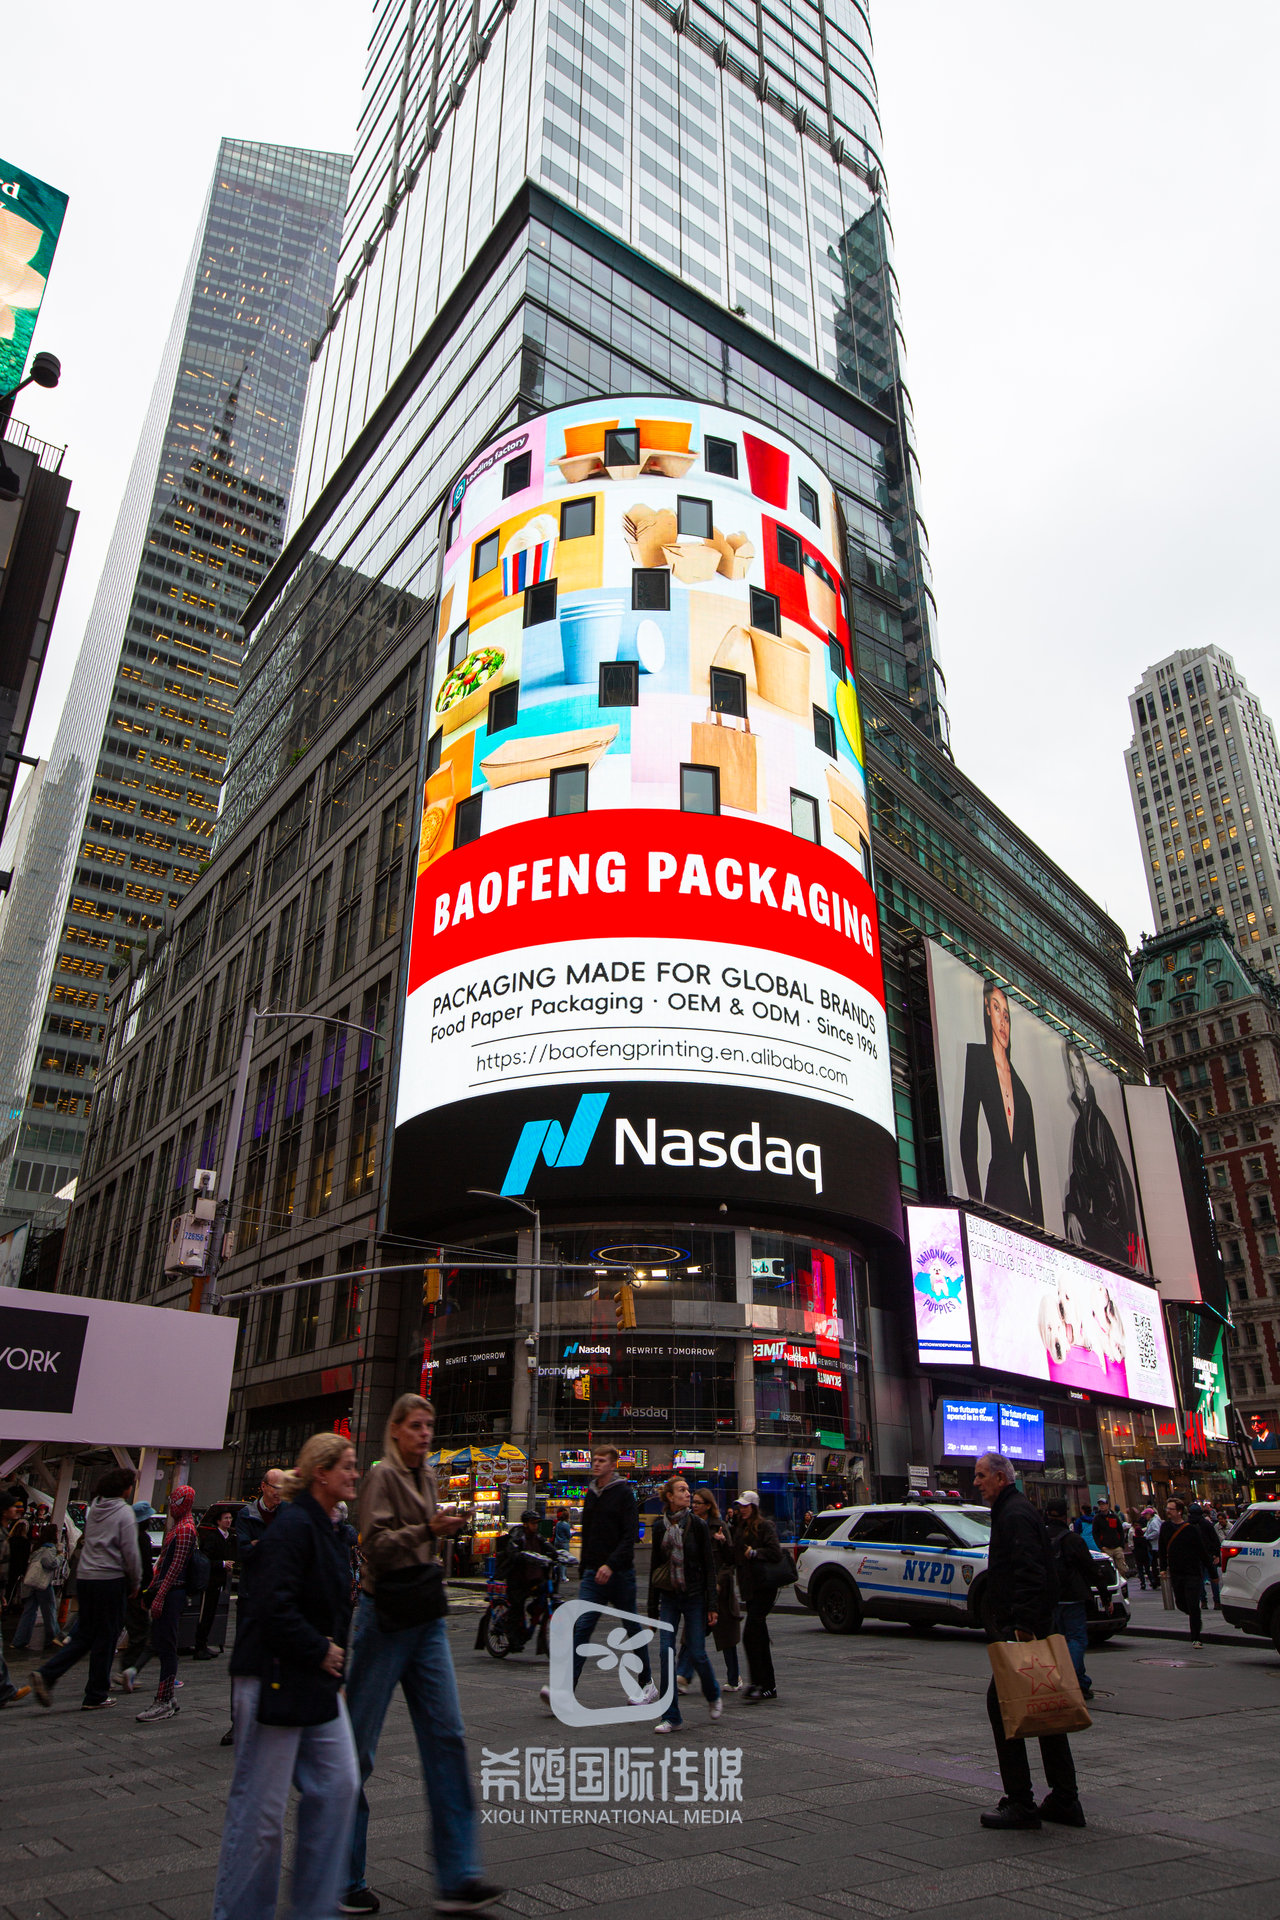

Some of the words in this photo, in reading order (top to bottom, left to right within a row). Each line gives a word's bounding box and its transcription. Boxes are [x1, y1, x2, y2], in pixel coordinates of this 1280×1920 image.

[466, 457, 494, 485] Leading
[495, 437, 526, 459] factory
[433, 851, 627, 937] BAOFENG
[648, 851, 874, 957] PACKAGING
[432, 967, 556, 1018] PACKAGING
[566, 961, 646, 986] MADE
[657, 962, 711, 985] FOR
[721, 967, 814, 1005] GLOBAL
[820, 989, 877, 1034] BRANDS
[431, 1015, 466, 1043] Food
[471, 1005, 524, 1029] Paper
[531, 992, 644, 1015] Packaging
[668, 993, 721, 1013] OEM
[729, 997, 745, 1016] &
[752, 1001, 801, 1026] ODM
[817, 1016, 854, 1045] Since
[857, 1032, 878, 1060] 1996
[476, 1040, 848, 1086] https://baofengprinting.en.alibaba.com
[615, 1118, 823, 1195] Nasdaq
[966, 1214, 1013, 1248] BRINGING
[1014, 1233, 1059, 1267] HAPPINESS
[916, 1248, 959, 1269] NATIONWIDE
[969, 1239, 992, 1263] ONE
[991, 1246, 1015, 1271] WAG
[923, 1299, 957, 1315] PUPPIES
[445, 1355, 468, 1366] REWRITE
[469, 1351, 506, 1362] TOMORROW
[578, 1344, 612, 1356] Nasdaq
[626, 1346, 664, 1355] REWRITE
[668, 1346, 715, 1356] TOMORROW
[622, 1406, 669, 1420] Nasdaq
[781, 1411, 801, 1424] Nasdaq
[946, 1405, 959, 1413] The
[959, 1405, 978, 1414] future
[979, 1406, 987, 1414] of
[946, 1413, 966, 1421] spend
[966, 1413, 972, 1421] is
[973, 1413, 979, 1421] in
[979, 1414, 994, 1422] flow.
[1001, 1407, 1010, 1417] The
[1027, 1413, 1039, 1422] spend
[903, 1559, 955, 1585] NYPD
